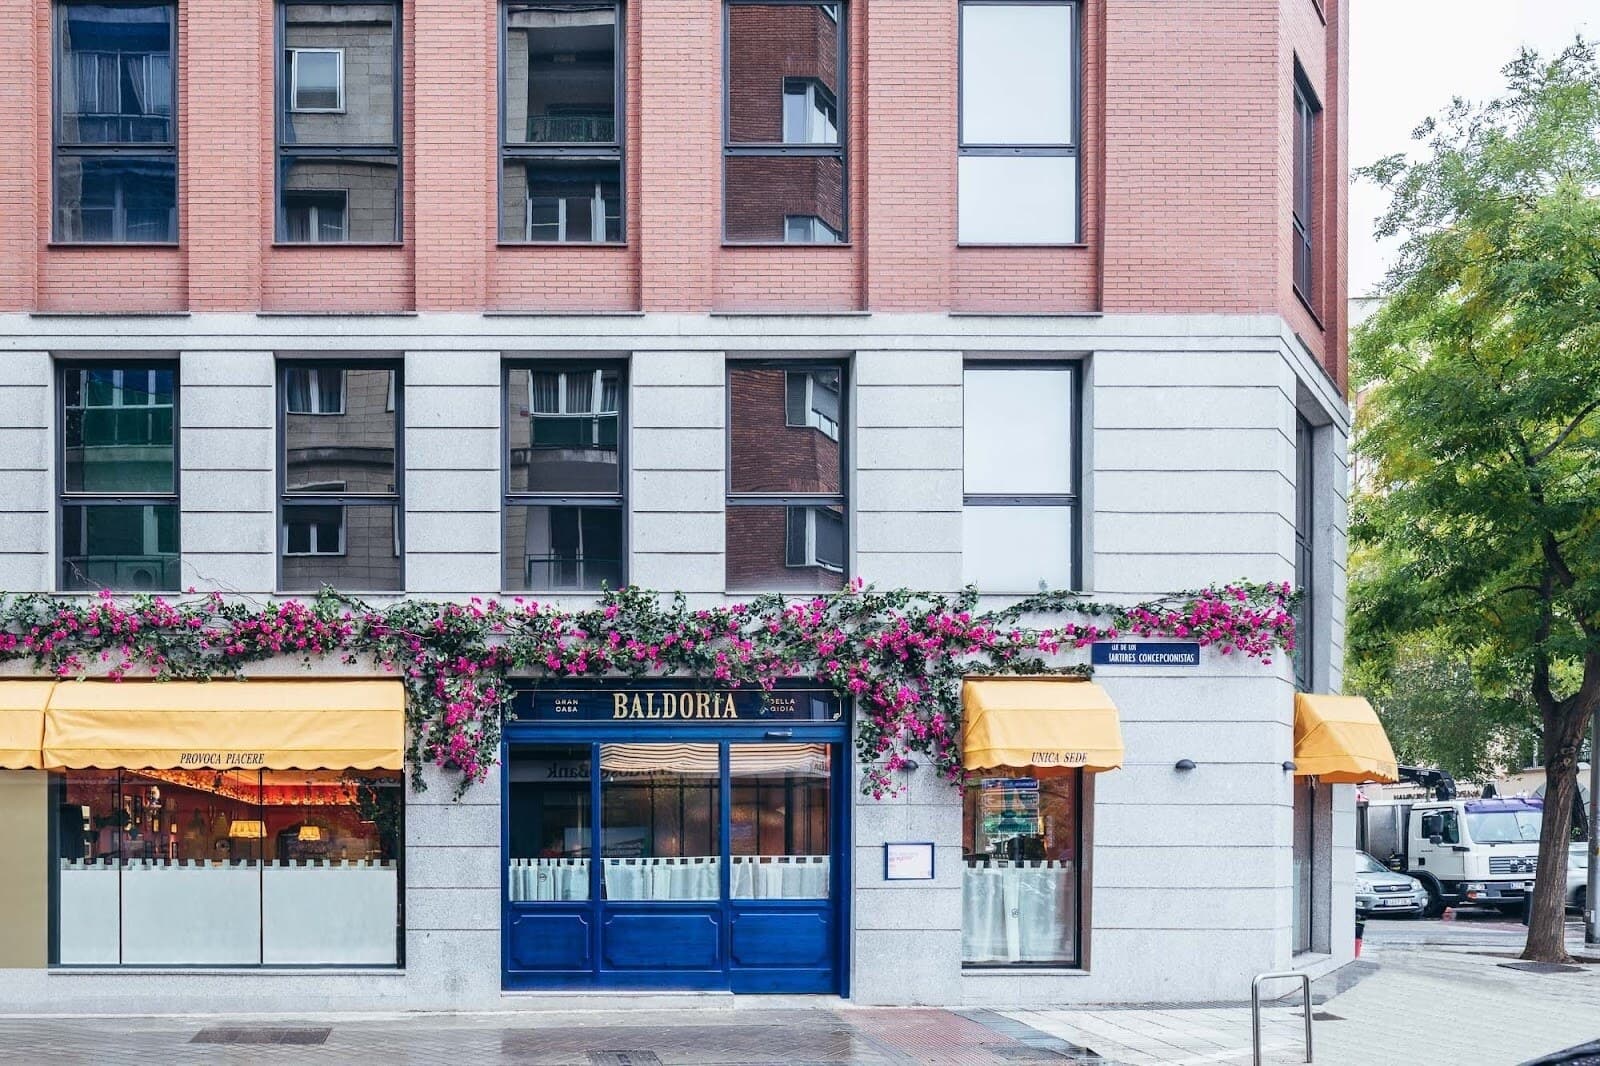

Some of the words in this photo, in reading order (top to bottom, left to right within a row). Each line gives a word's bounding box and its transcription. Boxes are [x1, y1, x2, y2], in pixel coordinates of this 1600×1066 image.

[1138, 653, 1195, 663] CONCEPCIONISTAS
[612, 692, 738, 719] BALDORIA
[180, 752, 221, 764] PROVOCA
[226, 752, 265, 764] PIACERE
[1031, 751, 1060, 763] UNICA
[1063, 751, 1088, 763] SEDE
